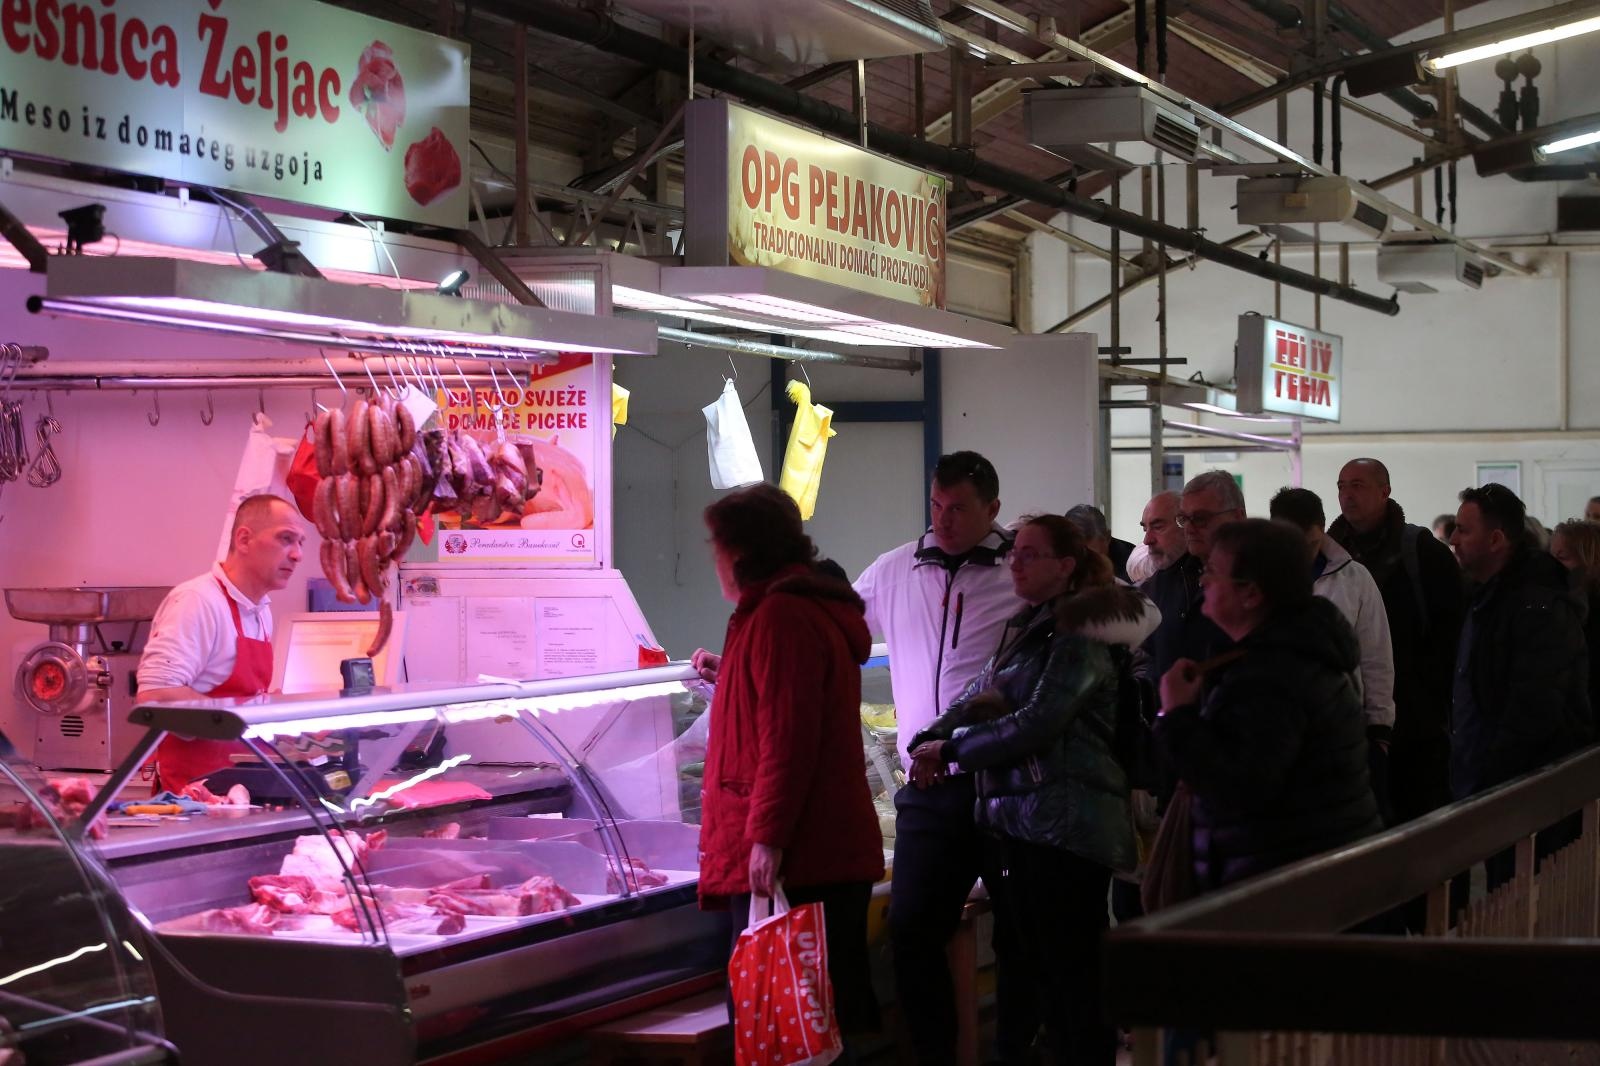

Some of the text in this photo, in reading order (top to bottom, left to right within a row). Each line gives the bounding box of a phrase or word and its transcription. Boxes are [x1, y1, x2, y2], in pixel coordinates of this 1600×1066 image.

[198, 0, 341, 133] Željac
[0, 88, 323, 185] Meso iz domaćeg uzgoja
[741, 144, 940, 260] OPG PEJAKOVIĆ
[754, 221, 929, 291] TRADICIONALNI DOMAĆI PROIZVODI
[448, 385, 587, 408] DNEVNO SVJEŽE
[449, 409, 587, 430] DOMAĆE PICEKE
